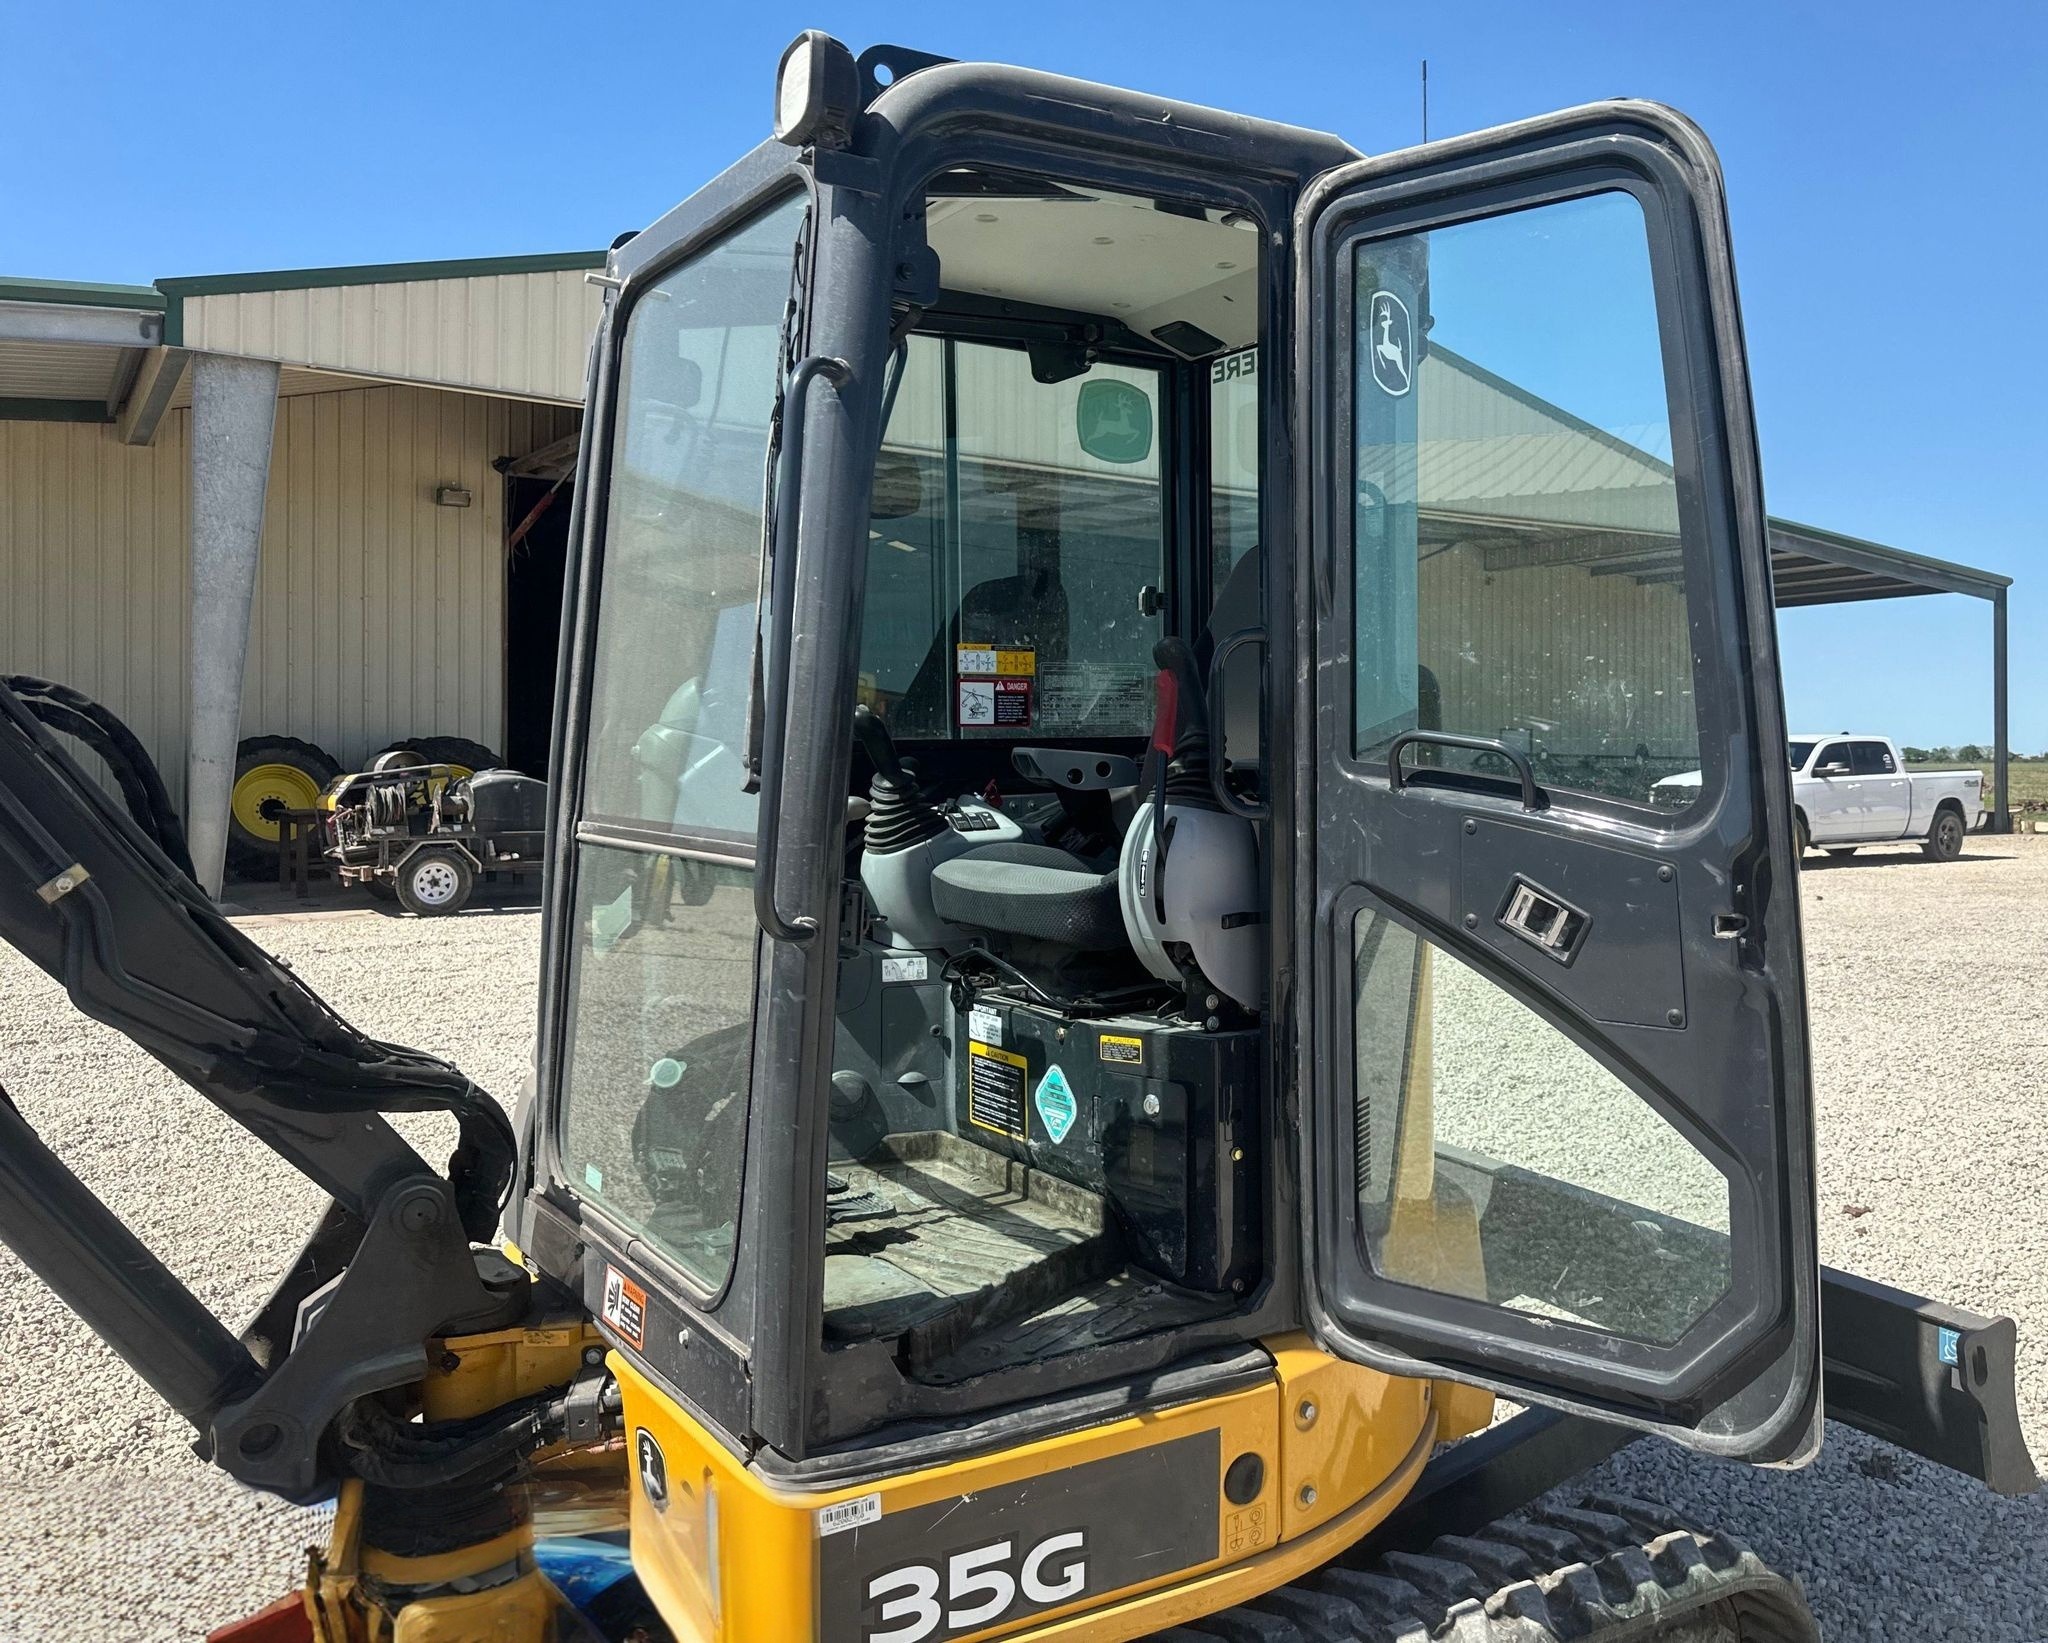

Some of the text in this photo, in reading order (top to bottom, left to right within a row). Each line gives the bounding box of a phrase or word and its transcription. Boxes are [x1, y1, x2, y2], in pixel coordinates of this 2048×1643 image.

[1006, 682, 1028, 691] DANGER
[990, 1049, 1009, 1062] CAUTION
[869, 1531, 1086, 1643] 35G
